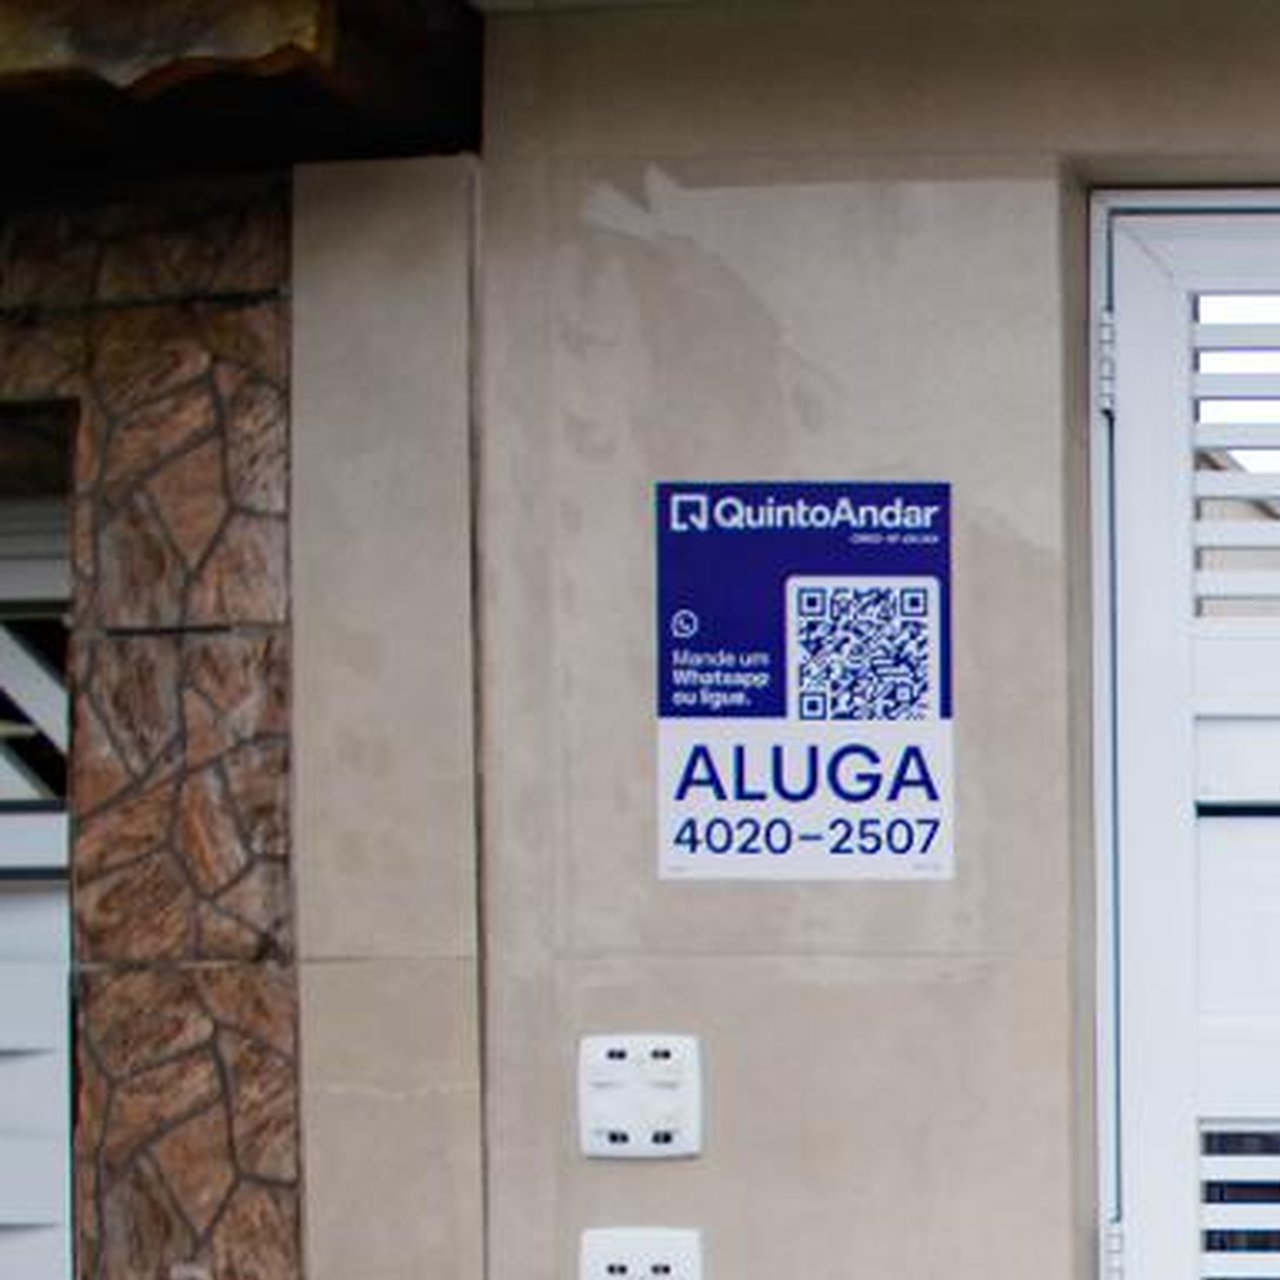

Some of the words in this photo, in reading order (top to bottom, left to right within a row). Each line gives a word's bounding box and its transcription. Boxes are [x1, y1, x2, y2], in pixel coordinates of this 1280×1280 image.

[714, 497, 939, 529] QuintoAndar
[672, 649, 735, 666] Mande
[739, 652, 769, 666] um
[672, 692, 697, 706] ou
[699, 687, 752, 710] ligue.
[675, 744, 939, 804] ALUGA
[674, 818, 941, 855] 4020-2507
